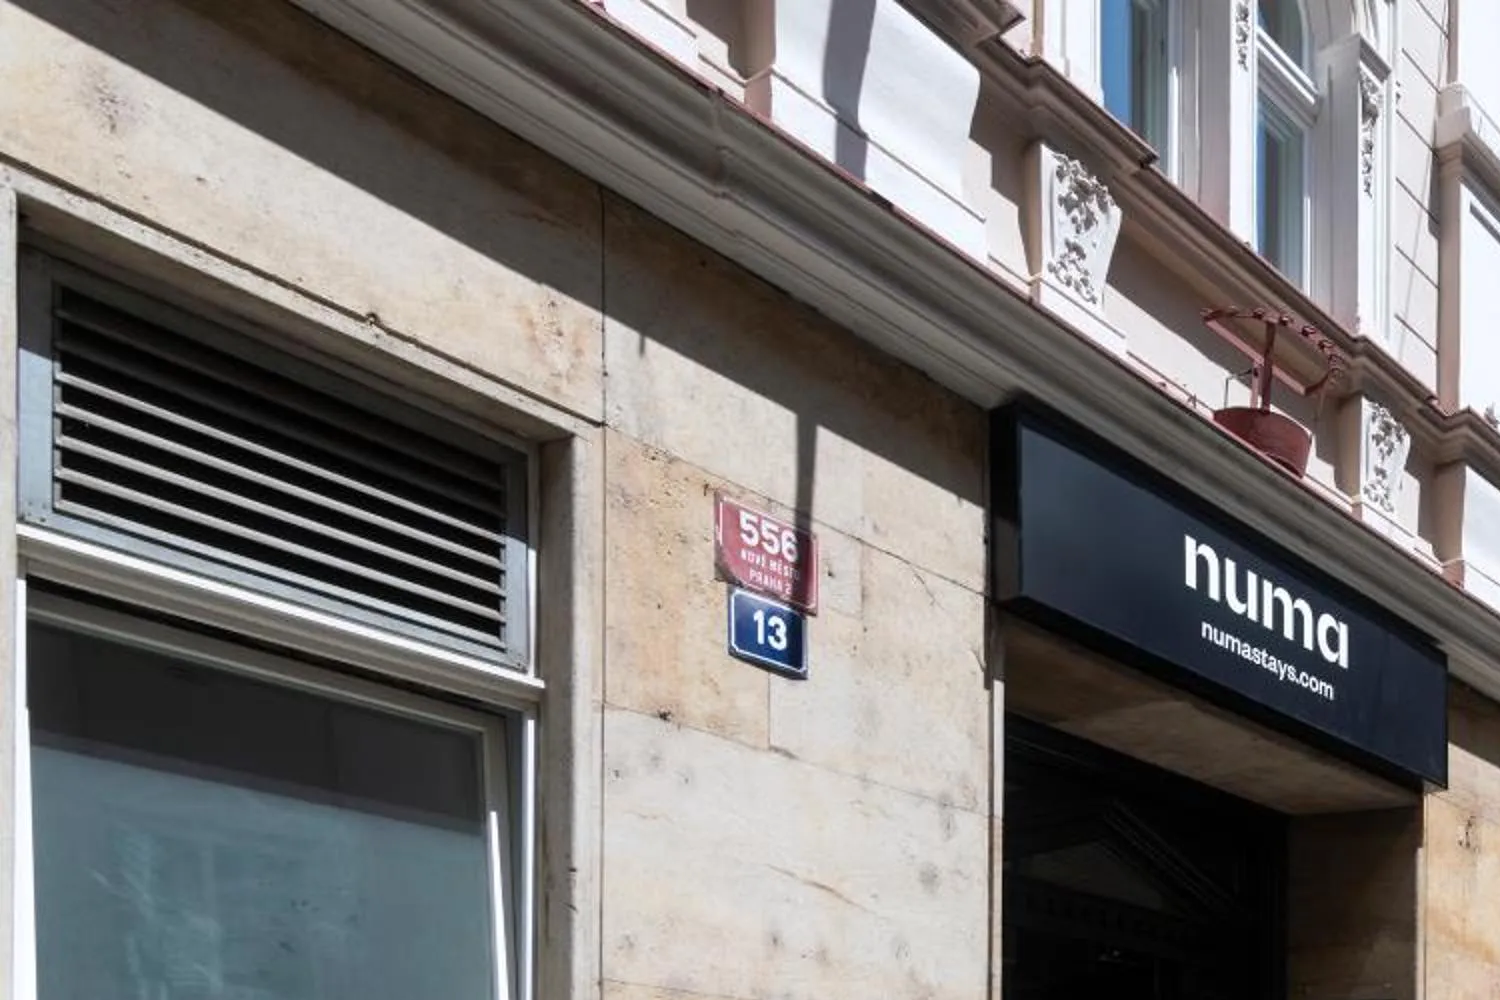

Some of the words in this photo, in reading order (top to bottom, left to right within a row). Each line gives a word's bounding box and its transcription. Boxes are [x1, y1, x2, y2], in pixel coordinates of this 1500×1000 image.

[738, 510, 799, 563] 556
[752, 608, 788, 651] 13
[1184, 534, 1349, 670] numa
[1201, 621, 1335, 700] numastays.com
